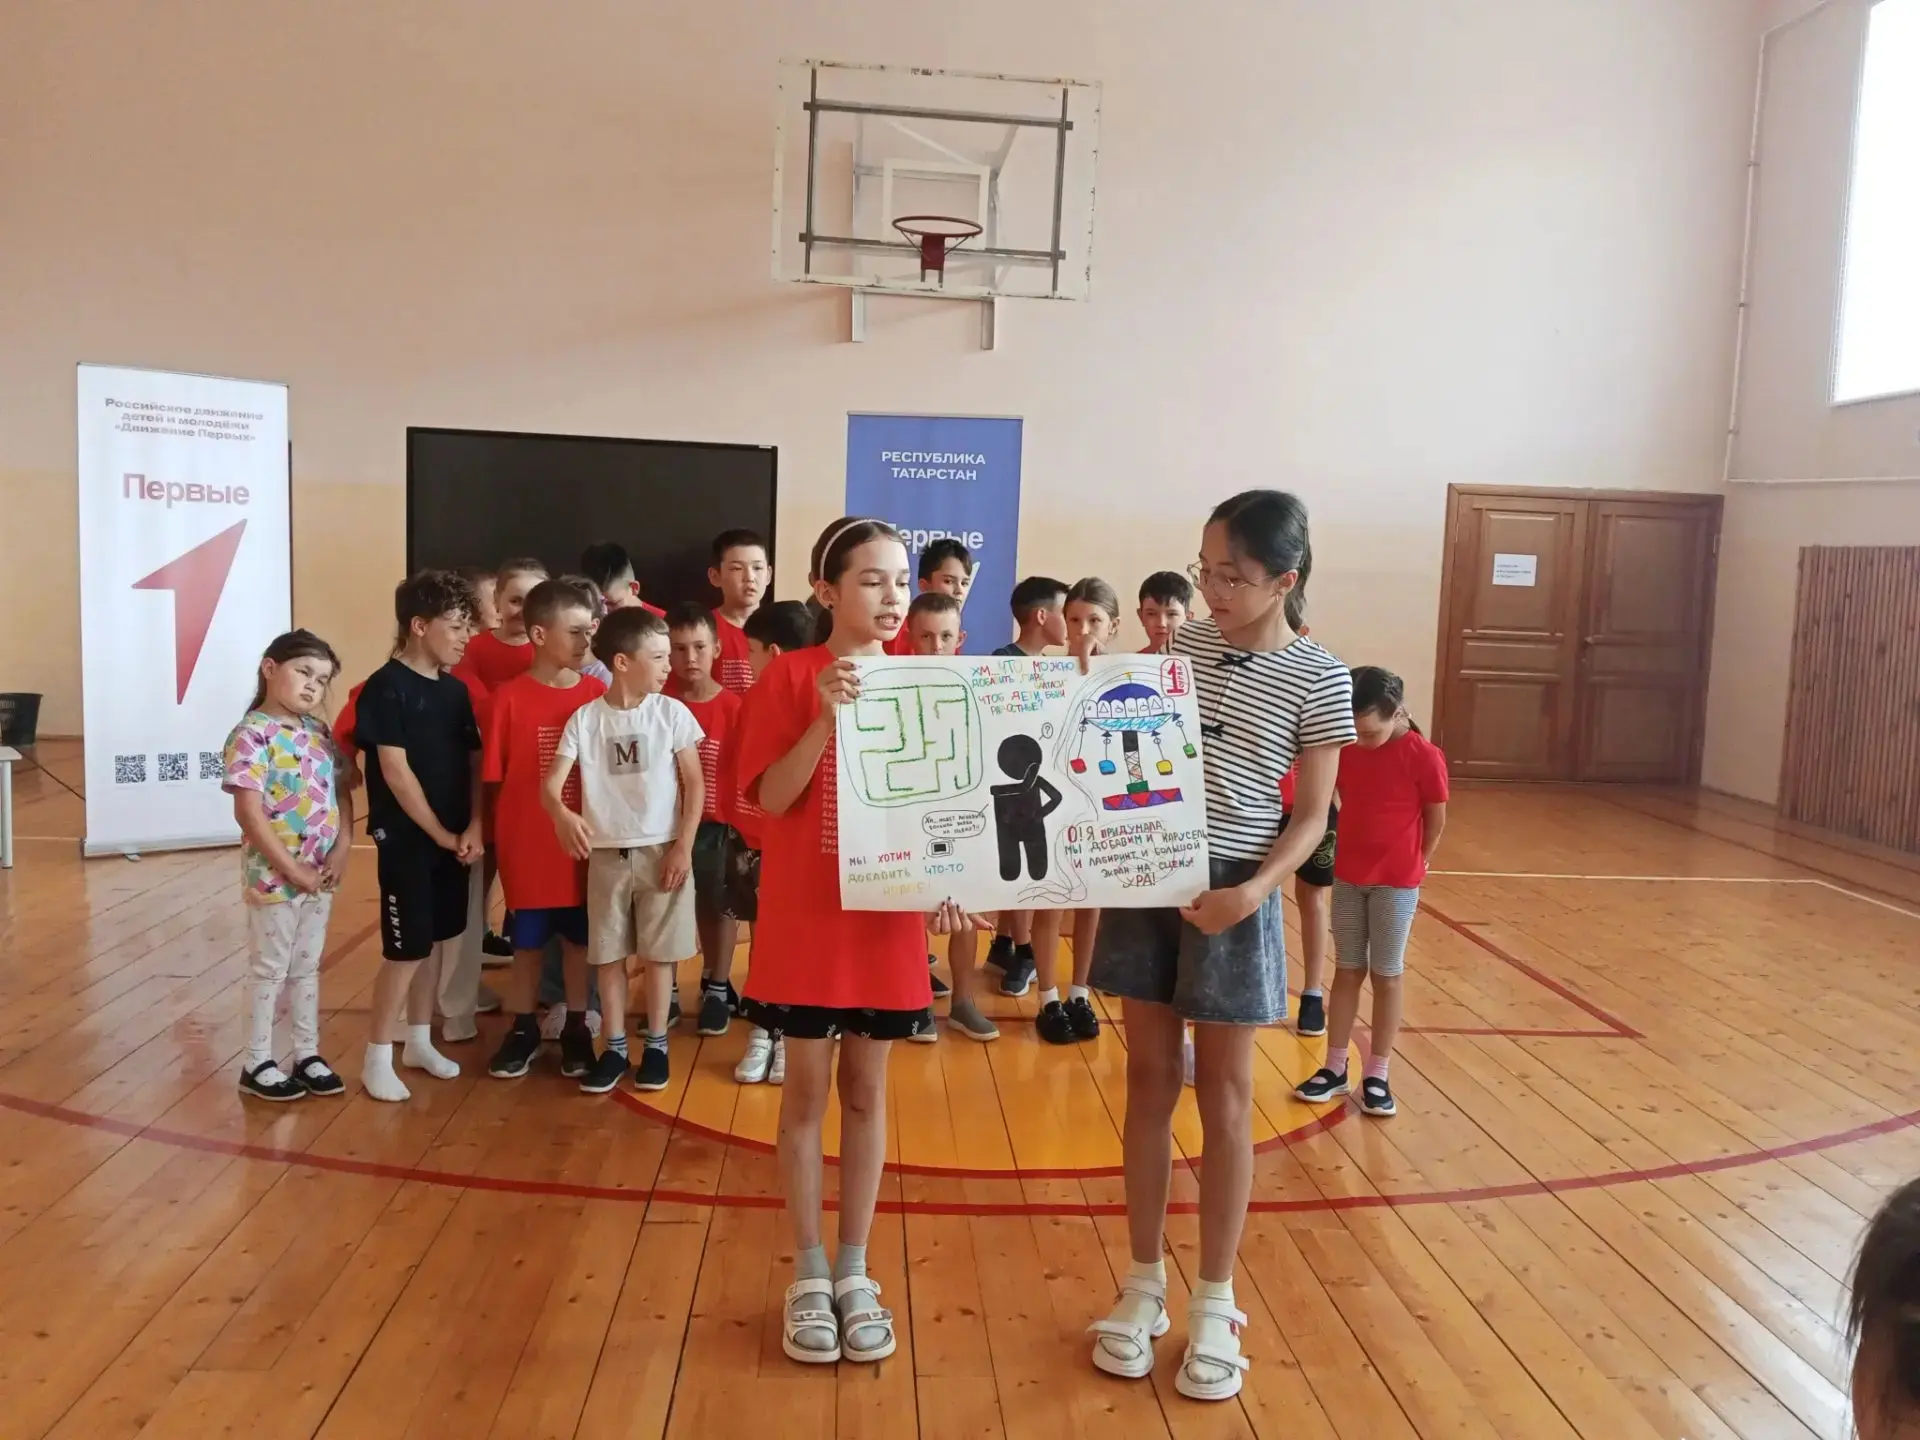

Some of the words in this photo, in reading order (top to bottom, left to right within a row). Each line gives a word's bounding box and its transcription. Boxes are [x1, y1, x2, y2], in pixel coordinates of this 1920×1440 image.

[105, 398, 192, 413] Российское
[194, 408, 264, 421] движение
[121, 412, 164, 422] детей
[166, 415, 176, 424] и
[114, 422, 195, 437] «Движение
[881, 451, 986, 465] РЕСПУБЛИКА
[891, 467, 977, 481] ТАТАРСТАН
[123, 472, 250, 509] Первые
[1032, 660, 1075, 673] МОЖНО
[614, 740, 640, 766] M
[1086, 825, 1096, 841] Я
[1065, 844, 1082, 855] МЫ
[1090, 835, 1143, 853] ДОБАВИМ
[1146, 834, 1154, 843] И
[849, 855, 867, 867] МЫ
[878, 850, 912, 864] ХОТИМ
[1073, 859, 1083, 868] И
[1088, 850, 1137, 867] ЛАБИРИНТ
[1154, 840, 1201, 856] БОЛЬШОЙ
[848, 867, 912, 884] ДОБАВИТЬ
[925, 862, 965, 876] ЧТО-ТО
[1100, 866, 1130, 879] ЭКРАН
[1136, 864, 1152, 873] НА
[1121, 872, 1156, 888] УРА!
[388, 894, 403, 950] BUNNY
